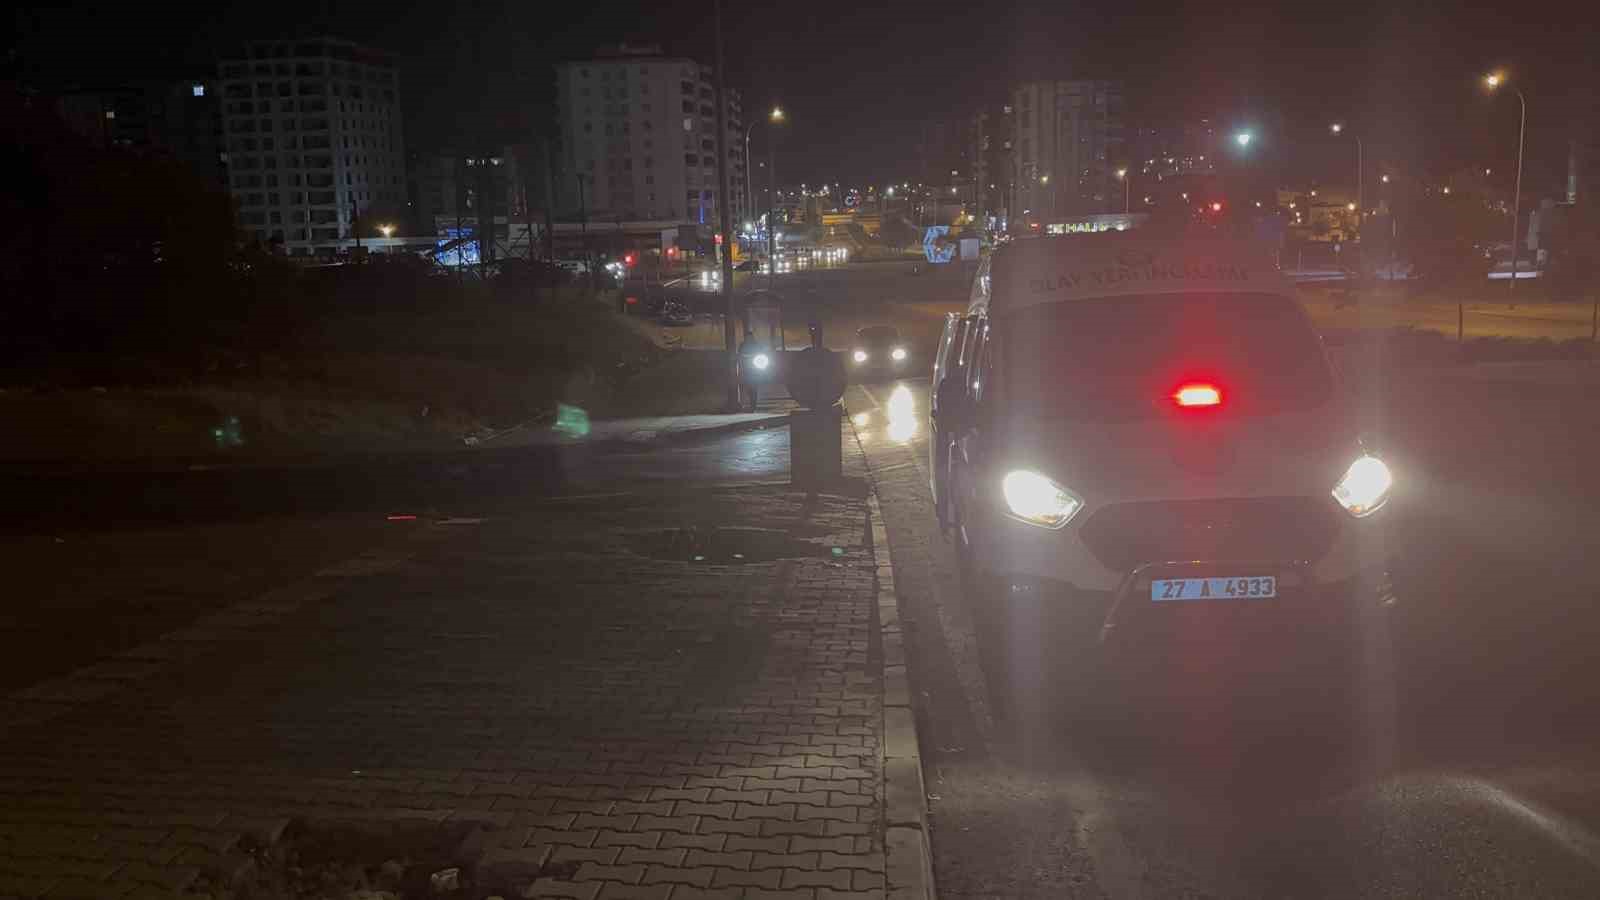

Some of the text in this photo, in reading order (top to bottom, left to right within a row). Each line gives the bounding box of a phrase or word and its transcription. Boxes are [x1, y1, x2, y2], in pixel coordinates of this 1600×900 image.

[1161, 578, 1273, 599] 27 A 4933
